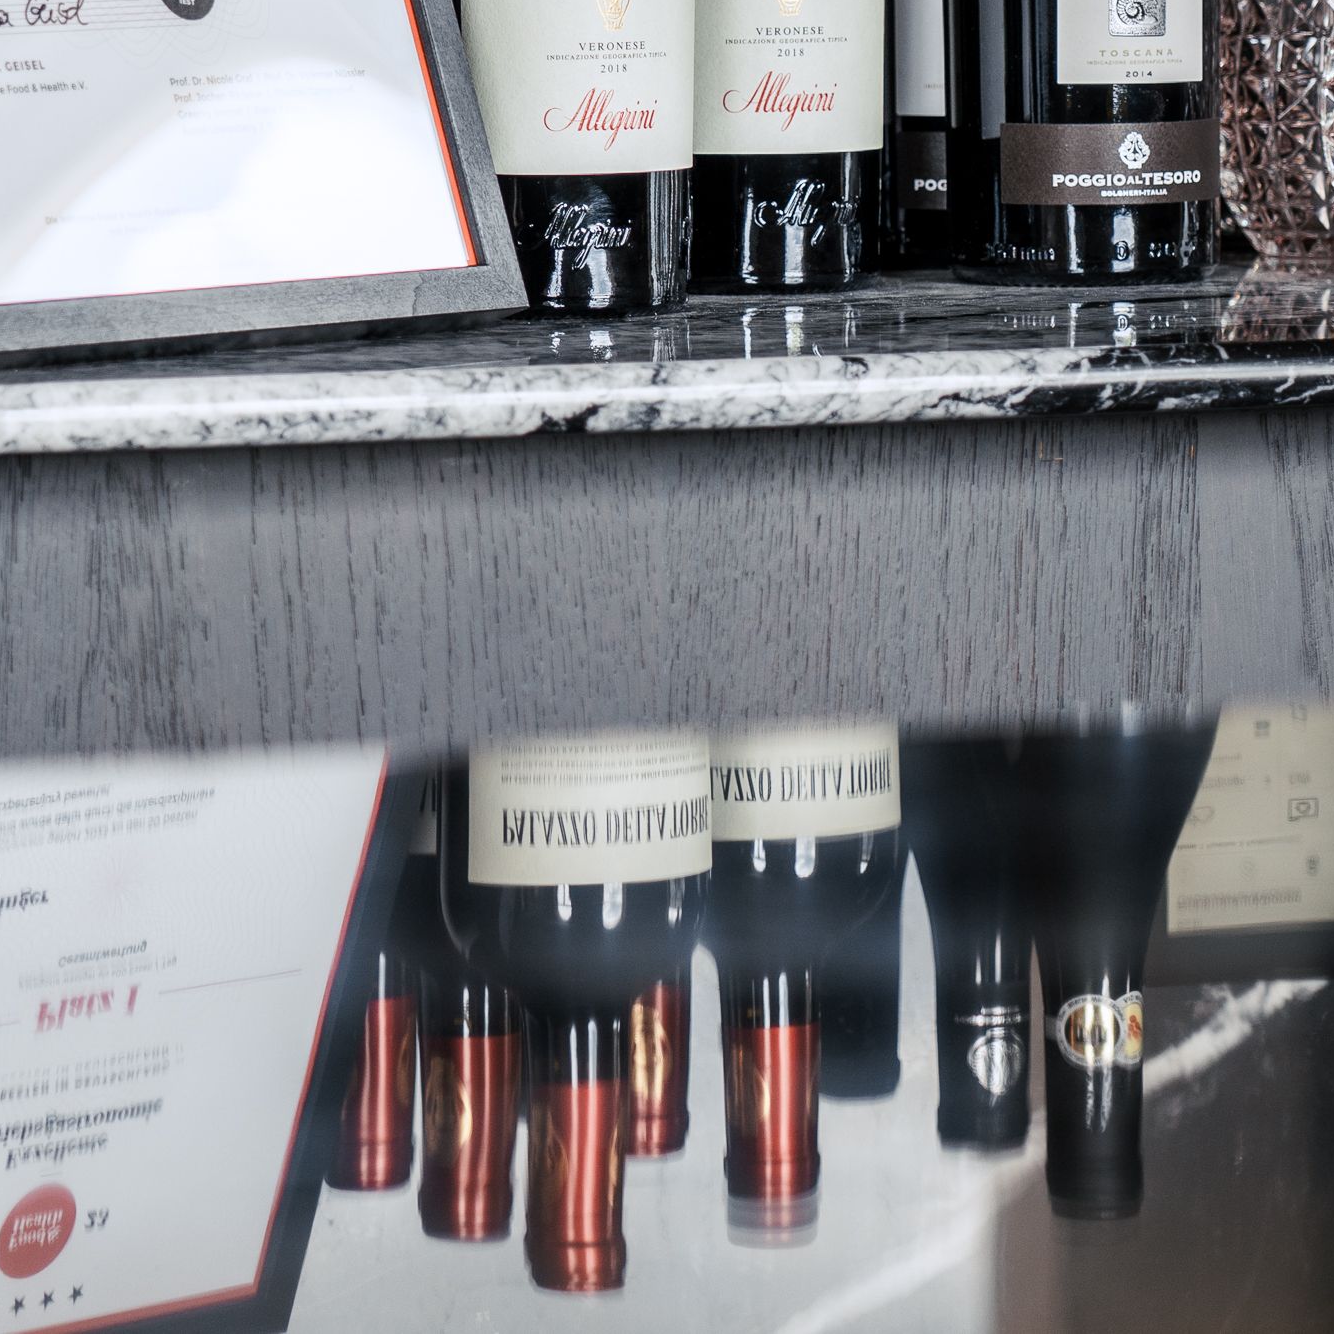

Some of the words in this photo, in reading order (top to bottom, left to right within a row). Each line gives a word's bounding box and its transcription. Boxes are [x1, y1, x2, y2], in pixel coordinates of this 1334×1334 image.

[756, 26, 824, 36] VERONESE
[579, 41, 646, 51] VERONESE
[777, 48, 804, 57] 2018
[1099, 49, 1173, 57] TOSCANA
[5, 60, 45, 72] GEISEL
[600, 64, 627, 73] 2018
[170, 76, 190, 87] Prof.
[192, 75, 205, 86] Dr.
[7, 84, 29, 94] Food
[31, 84, 38, 93] &
[40, 82, 69, 93] Health
[71, 81, 87, 91] e.V.
[723, 71, 837, 131] Allegrini
[544, 87, 657, 151] Allegrini
[1101, 189, 1167, 197] BOLGHERI-ITALIA
